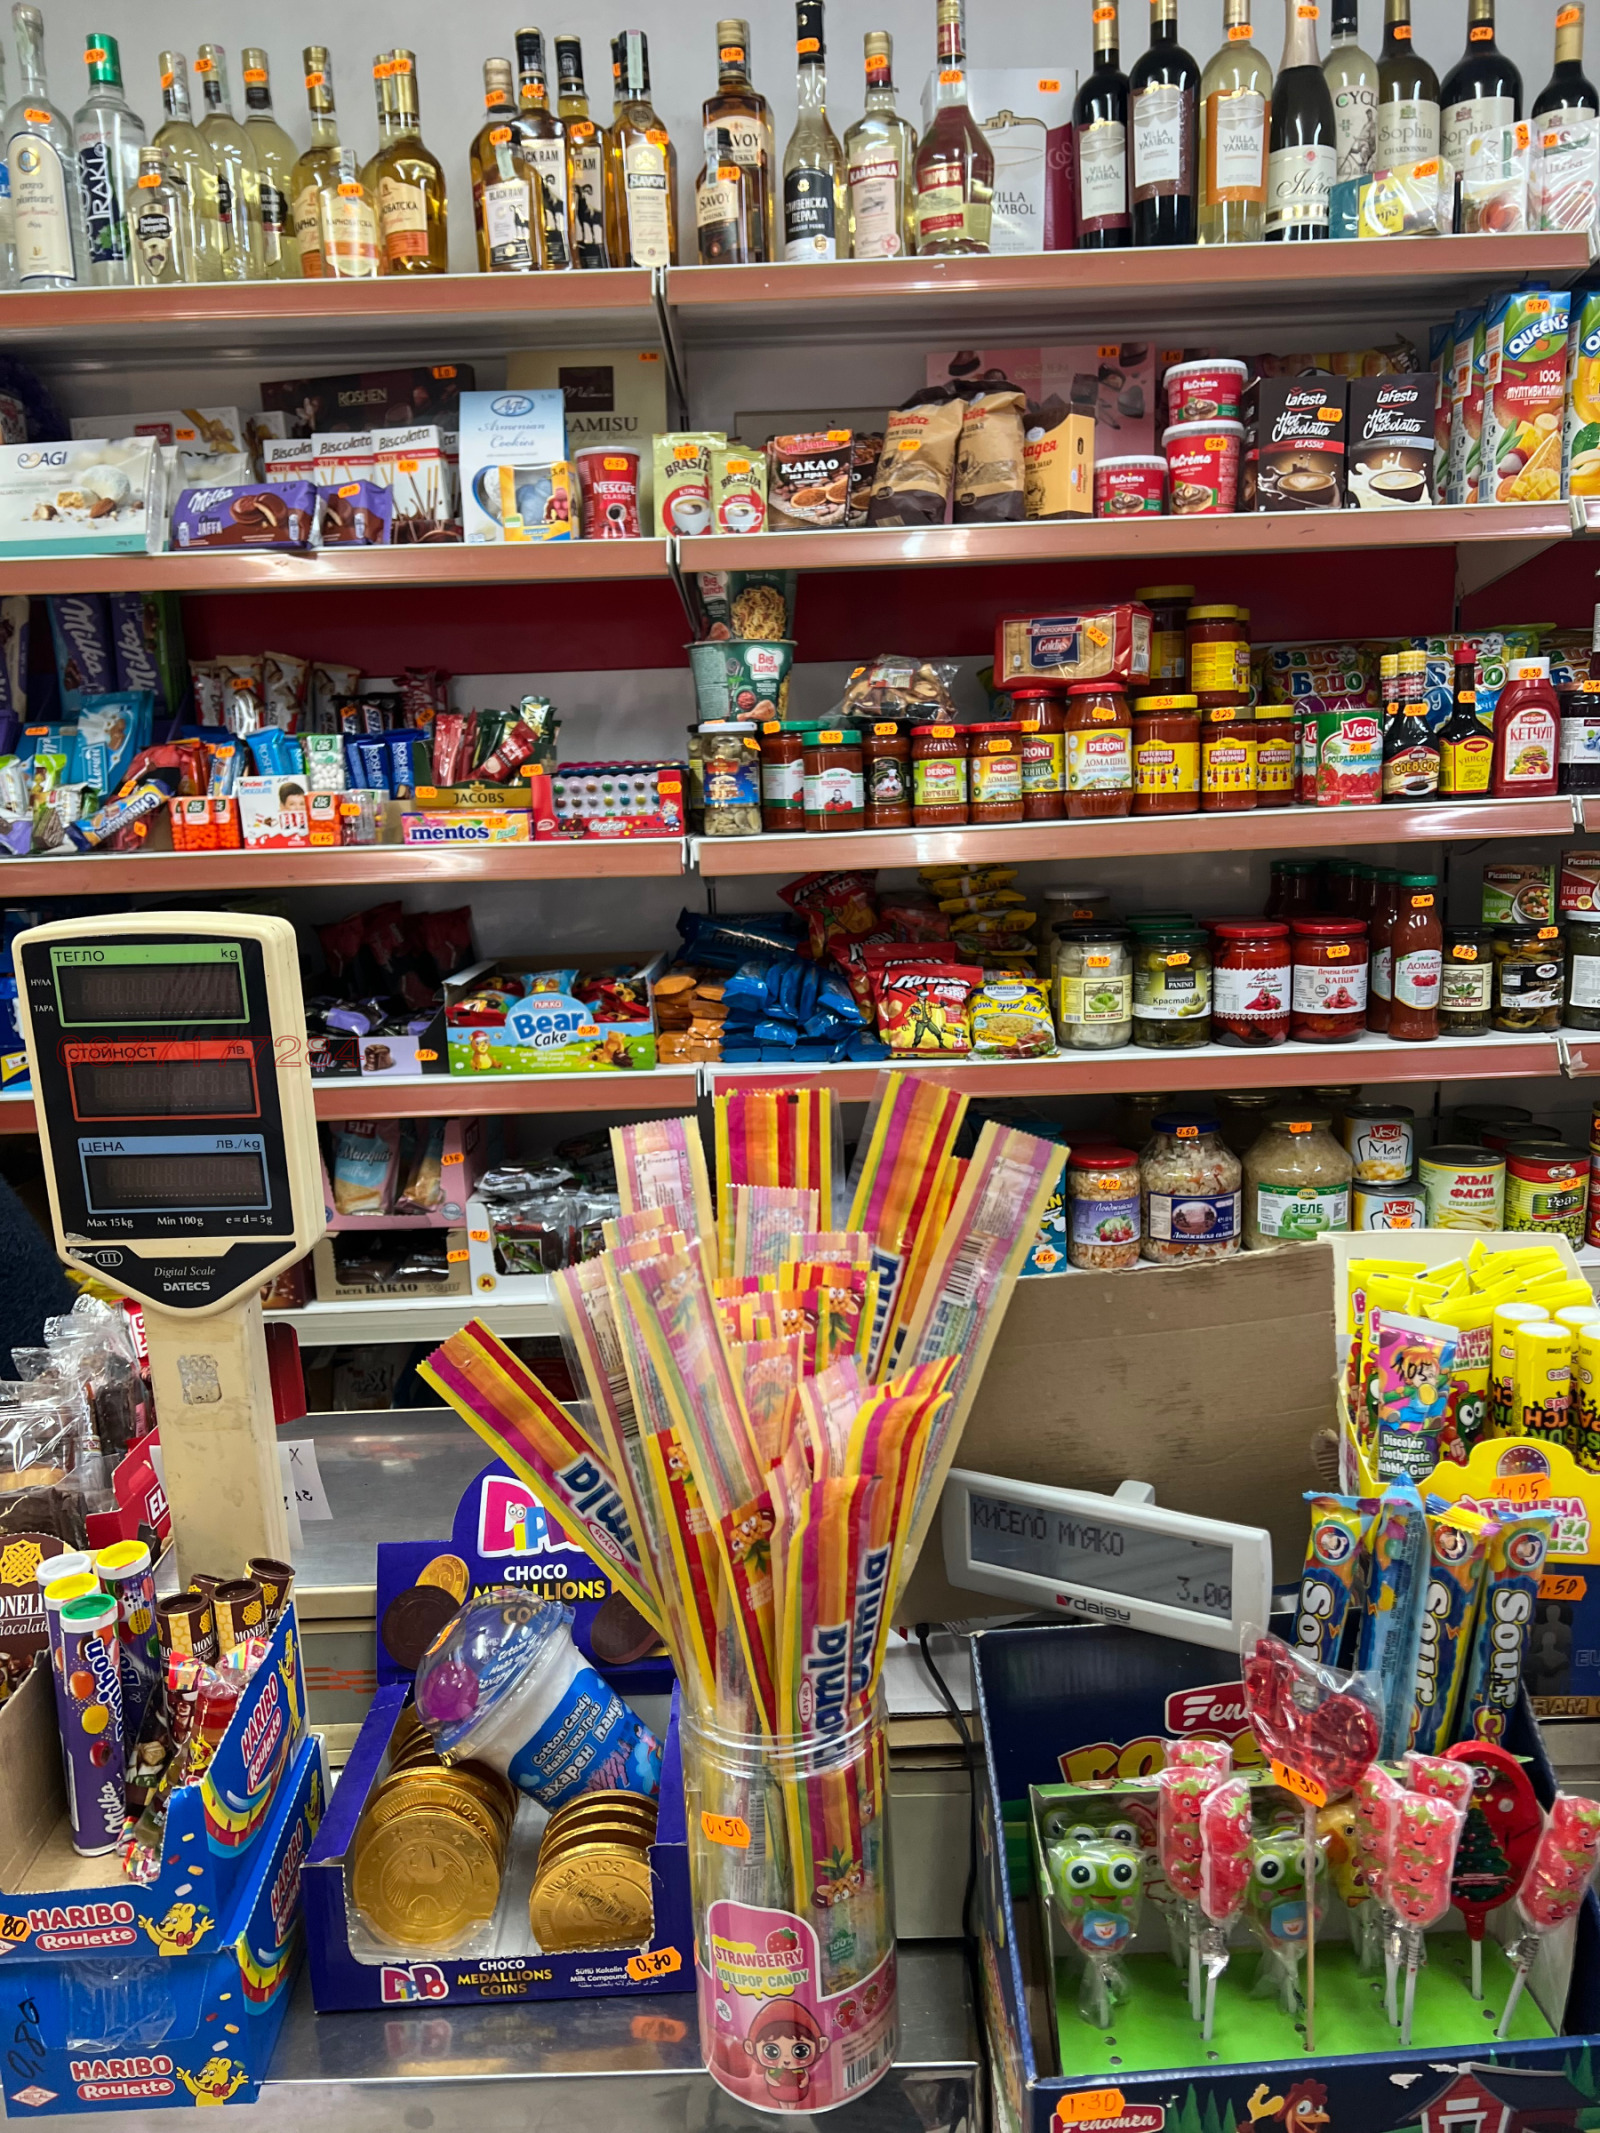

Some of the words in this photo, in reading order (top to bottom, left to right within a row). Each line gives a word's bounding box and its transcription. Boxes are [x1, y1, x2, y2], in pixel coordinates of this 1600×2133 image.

[1336, 90, 1379, 110] CYCL
[1229, 135, 1254, 144] VILLA
[1379, 123, 1432, 143] Sophia
[1223, 142, 1260, 152] YAMBOL
[1089, 164, 1114, 173] VILLA
[1085, 172, 1121, 183] YAMBOL
[1539, 369, 1561, 382] 100%
[338, 387, 387, 403] ROSHEN
[780, 458, 839, 474] КАКАО
[187, 486, 235, 514] Milka
[757, 653, 775, 666] Big
[753, 664, 778, 674] Lunch
[1510, 725, 1553, 741] КЕТЧУП
[1088, 742, 1125, 753] DERONI
[992, 764, 1017, 773] DERONI
[1084, 757, 1128, 768] ДОМАШНА
[1392, 759, 1419, 776] СОЕВ
[926, 768, 955, 777] DERONI
[453, 790, 505, 804] JACOBS
[410, 824, 490, 841] mentos
[1488, 871, 1521, 880] Picantina
[53, 950, 105, 963] ТЕГЛО
[220, 948, 238, 961] kg
[30, 978, 52, 987] НУЛА
[1168, 981, 1194, 989] PANINO
[1325, 976, 1355, 984] КАПИЯ
[34, 1004, 54, 1013] ТАРА
[513, 1011, 584, 1040] Bear
[534, 1033, 567, 1047] Cake
[68, 1044, 157, 1061] СТОЙНОСТ
[81, 1140, 125, 1154] ЦЕНА
[1368, 1140, 1403, 1156] Mais
[1454, 1174, 1495, 1185] ЖЪЛТ
[1450, 1187, 1495, 1199] ФАСУЛ
[1292, 1203, 1323, 1214] ЗЕЛЕ
[86, 1216, 107, 1228] Max
[157, 1215, 177, 1226] Min
[153, 1266, 187, 1278] Digital
[190, 1265, 216, 1276] Scale
[163, 1282, 211, 1292] DATECS
[365, 1283, 418, 1294] КАКАО
[1383, 1434, 1424, 1449] Discolor
[1409, 1462, 1434, 1476] Gum
[1058, 1519, 1125, 1557] МЛЯКО
[503, 1564, 568, 1582] CHOCO
[1176, 1576, 1232, 1611] 3.00
[1075, 1598, 1131, 1621] daisy
[1491, 1588, 1532, 1709] Sour
[240, 1672, 279, 1770] HARIBO
[531, 1723, 565, 1769] Cotton
[560, 1691, 592, 1735] Candy
[247, 1706, 282, 1794] Roulette
[30, 1903, 133, 1930] HARIBO
[1, 1915, 27, 1937] 80
[42, 1929, 134, 1949] Roulette
[714, 1945, 803, 1968] STRAWBERRY
[479, 1959, 526, 1971] CHOCO
[457, 1968, 553, 1985] MEDALLIONS
[570, 1974, 586, 1982] Milk
[716, 1967, 763, 1987] LOLLIPOP
[767, 1968, 809, 1987] CANDY
[480, 1982, 528, 1996] COINS
[71, 2056, 173, 2081] HARIBO
[83, 2080, 171, 2099] Roulette
